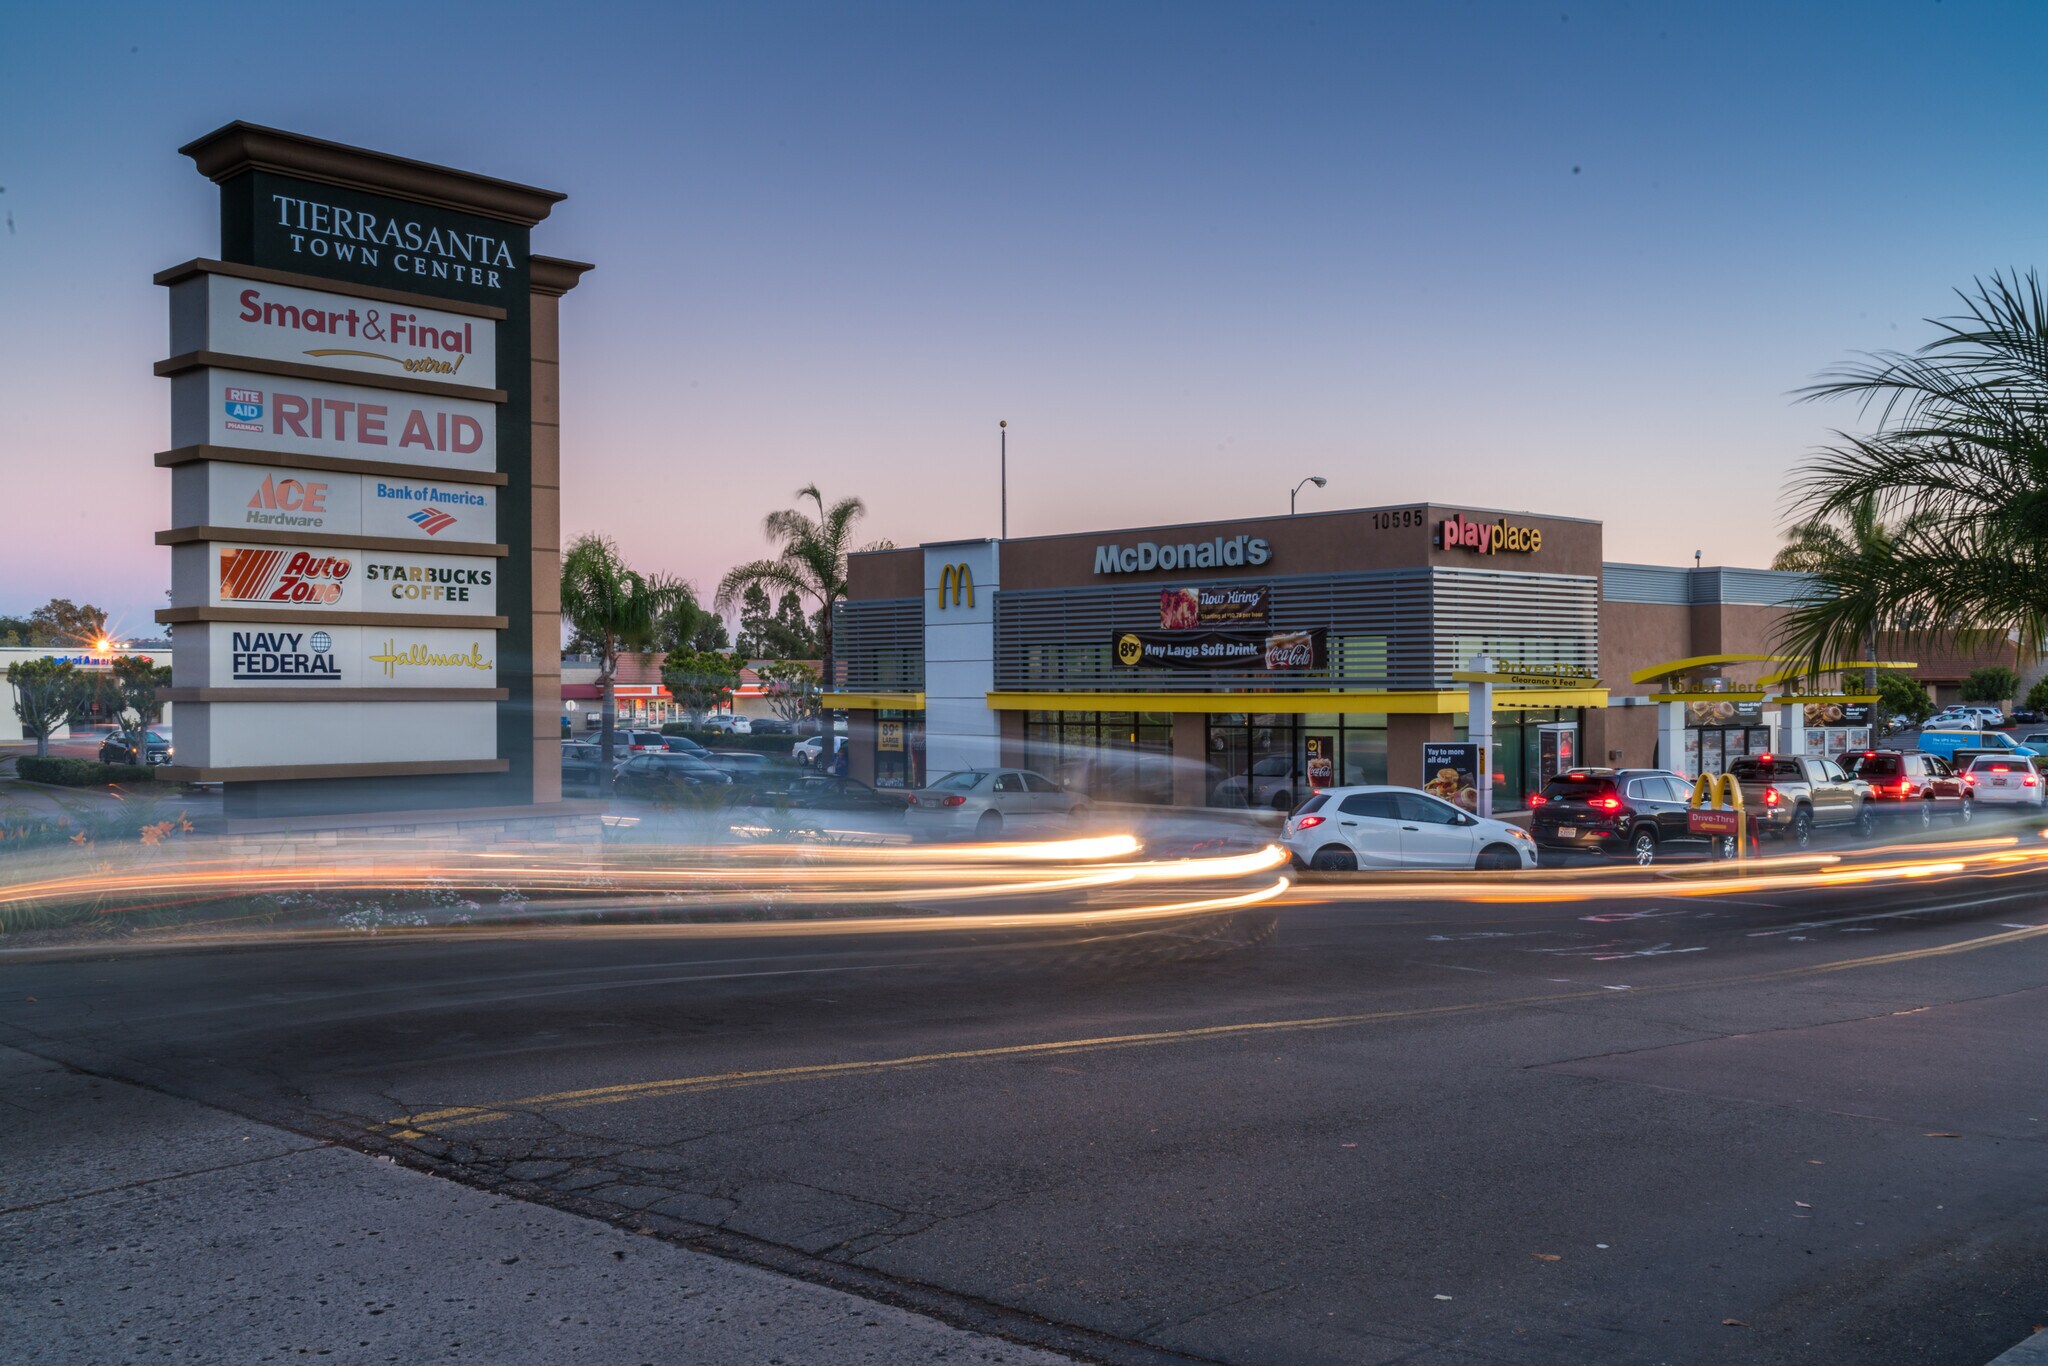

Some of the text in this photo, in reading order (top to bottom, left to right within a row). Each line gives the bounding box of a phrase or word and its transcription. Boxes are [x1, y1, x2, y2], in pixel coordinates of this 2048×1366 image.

[273, 194, 516, 269] TIERRASANTA
[290, 233, 501, 288] TOWN CENTER
[403, 354, 465, 375] extra!
[230, 389, 259, 403] RITE
[233, 404, 258, 418] AID
[227, 422, 263, 431] PHARMACY
[272, 392, 483, 454] RITE AID
[247, 472, 328, 512] ACE
[377, 483, 485, 506] Bank of America
[246, 511, 323, 527] Hardware
[1372, 510, 1422, 530] 10595
[1443, 513, 1541, 555] playplace
[1094, 535, 1271, 574] McDonald's
[284, 552, 351, 579] Auto
[366, 564, 492, 586] STARBUCKS
[269, 576, 342, 604] Zone
[391, 583, 469, 602] COFFEE
[1200, 591, 1260, 606] Now Hiring
[233, 632, 303, 652] NAVY
[1144, 643, 1166, 658] Any
[1167, 644, 1199, 658] Large
[1201, 643, 1224, 656] Soft
[1226, 643, 1258, 656] Drink
[72, 656, 82, 665] of
[233, 653, 341, 673] FEDERAL
[368, 638, 492, 679] Hallmark
[1499, 659, 1592, 678] Drive-Thru
[1511, 676, 1576, 686] Clearance 9 Feet
[1727, 681, 1763, 692] Here
[1845, 685, 1879, 695] Here
[1427, 748, 1439, 756] Yay
[1692, 813, 1735, 823] Drive-Thru
